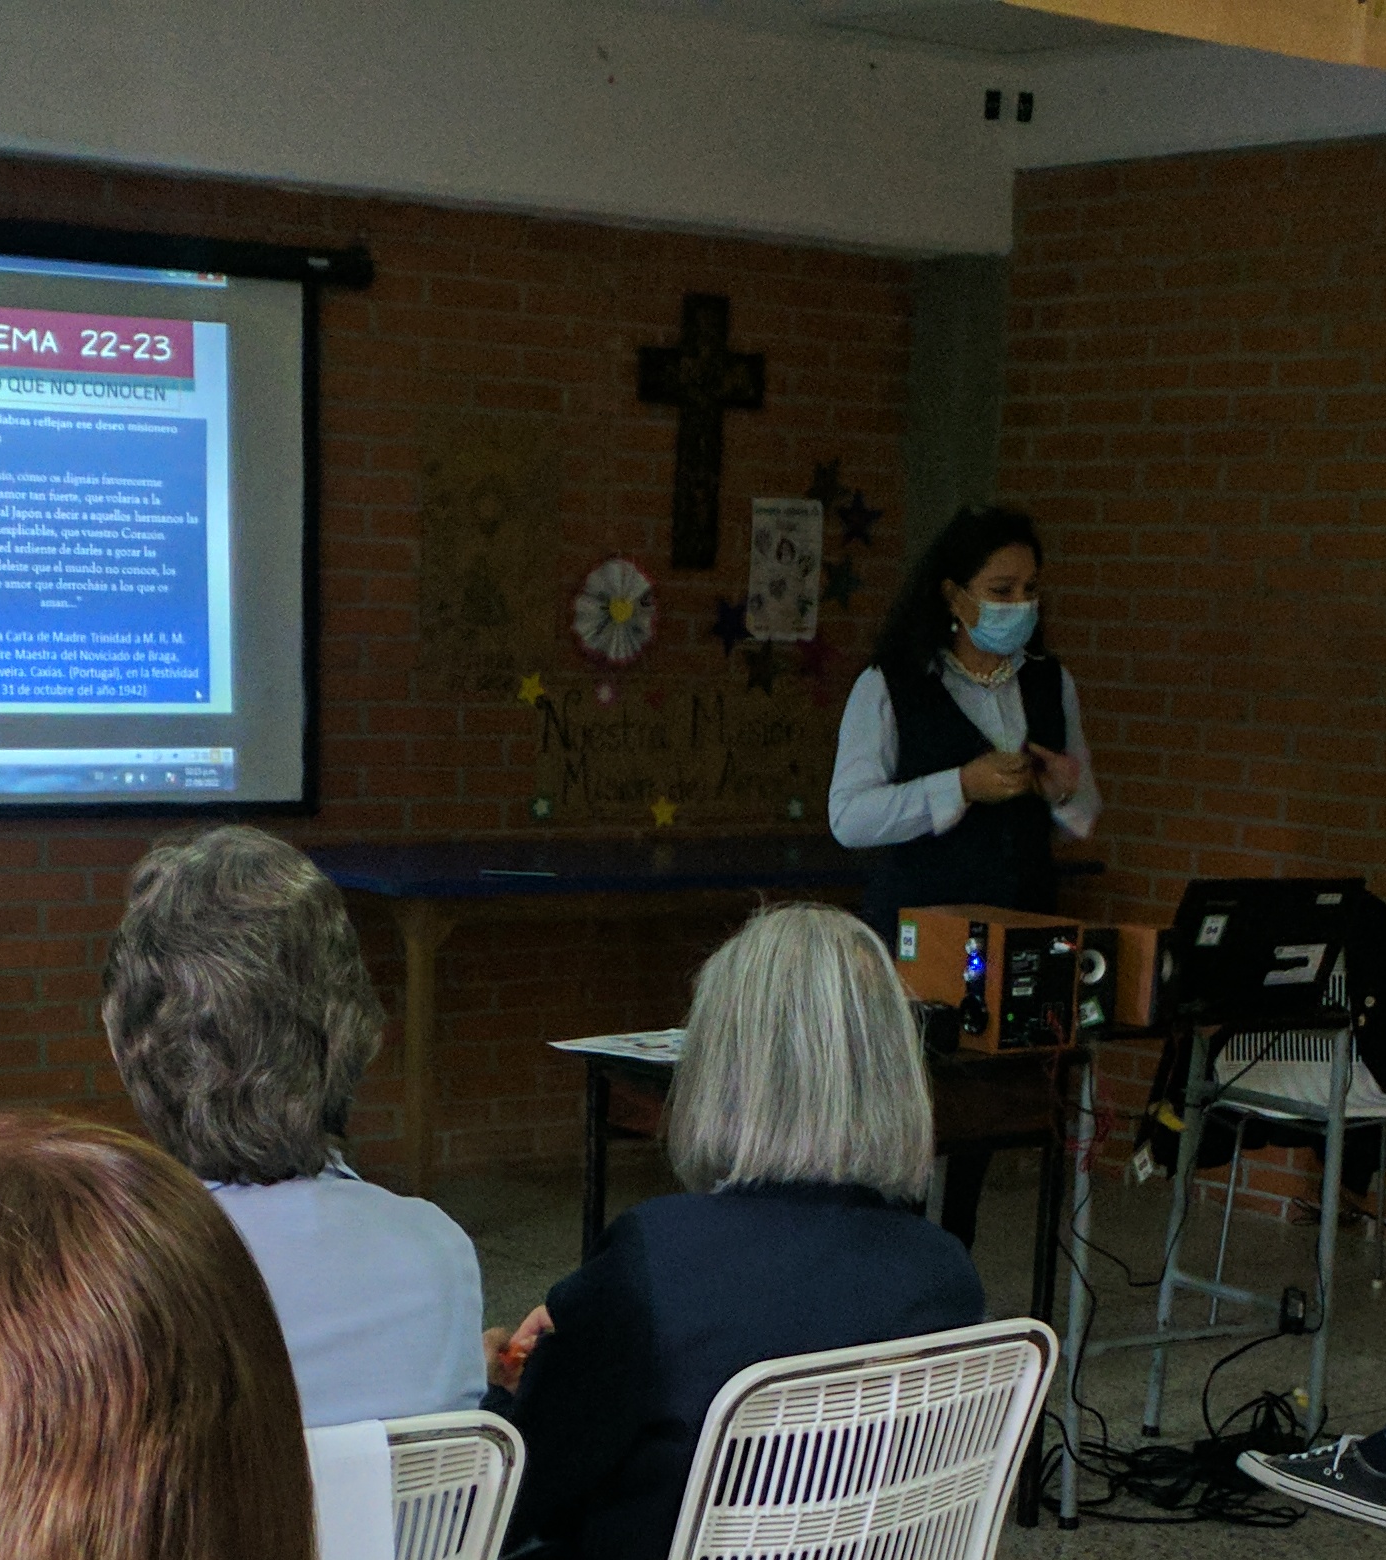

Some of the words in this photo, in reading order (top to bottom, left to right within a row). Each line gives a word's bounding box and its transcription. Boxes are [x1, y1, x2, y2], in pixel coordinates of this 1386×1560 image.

[80, 330, 172, 361] 22-23
[7, 377, 45, 395] QUE
[51, 378, 79, 396] NO
[82, 380, 165, 400] CONOCEN
[33, 417, 73, 431] reflejan
[77, 420, 92, 430] ese
[95, 420, 125, 431] deseo
[128, 422, 178, 434] misionero
[0, 490, 25, 499] amor
[29, 491, 45, 500] tan
[85, 493, 104, 505] que
[0, 506, 9, 518] al
[11, 506, 42, 521] Japón
[54, 508, 79, 519] decir
[91, 509, 131, 524] aquellos
[135, 509, 183, 522] hermanos
[61, 528, 81, 541] que
[81, 528, 118, 538] vuestro
[15, 543, 56, 555] ardiente
[59, 544, 71, 555] de
[73, 544, 102, 556] darles
[115, 548, 141, 559] gozar
[143, 546, 156, 557] las
[32, 563, 51, 574] que
[53, 561, 63, 572] el
[65, 561, 102, 574] mundo
[105, 565, 119, 574] no
[163, 564, 176, 576] los
[5, 580, 32, 589] amor
[35, 581, 53, 592] que
[120, 580, 134, 592] los
[137, 584, 155, 594] que
[5, 630, 34, 642] Carta
[37, 631, 49, 642] de
[53, 632, 86, 643] Madre
[91, 632, 131, 644] Trinidad
[15, 649, 57, 660] Maestra
[61, 650, 77, 661] del
[80, 650, 129, 662] Noviciado
[133, 650, 146, 662] de
[126, 670, 138, 678] en
[141, 667, 150, 678] la
[151, 667, 199, 679] festividad
[2, 684, 13, 695] 31
[17, 684, 30, 695] de
[33, 684, 74, 696] octubre
[77, 684, 93, 696] del
[96, 686, 116, 696] año
